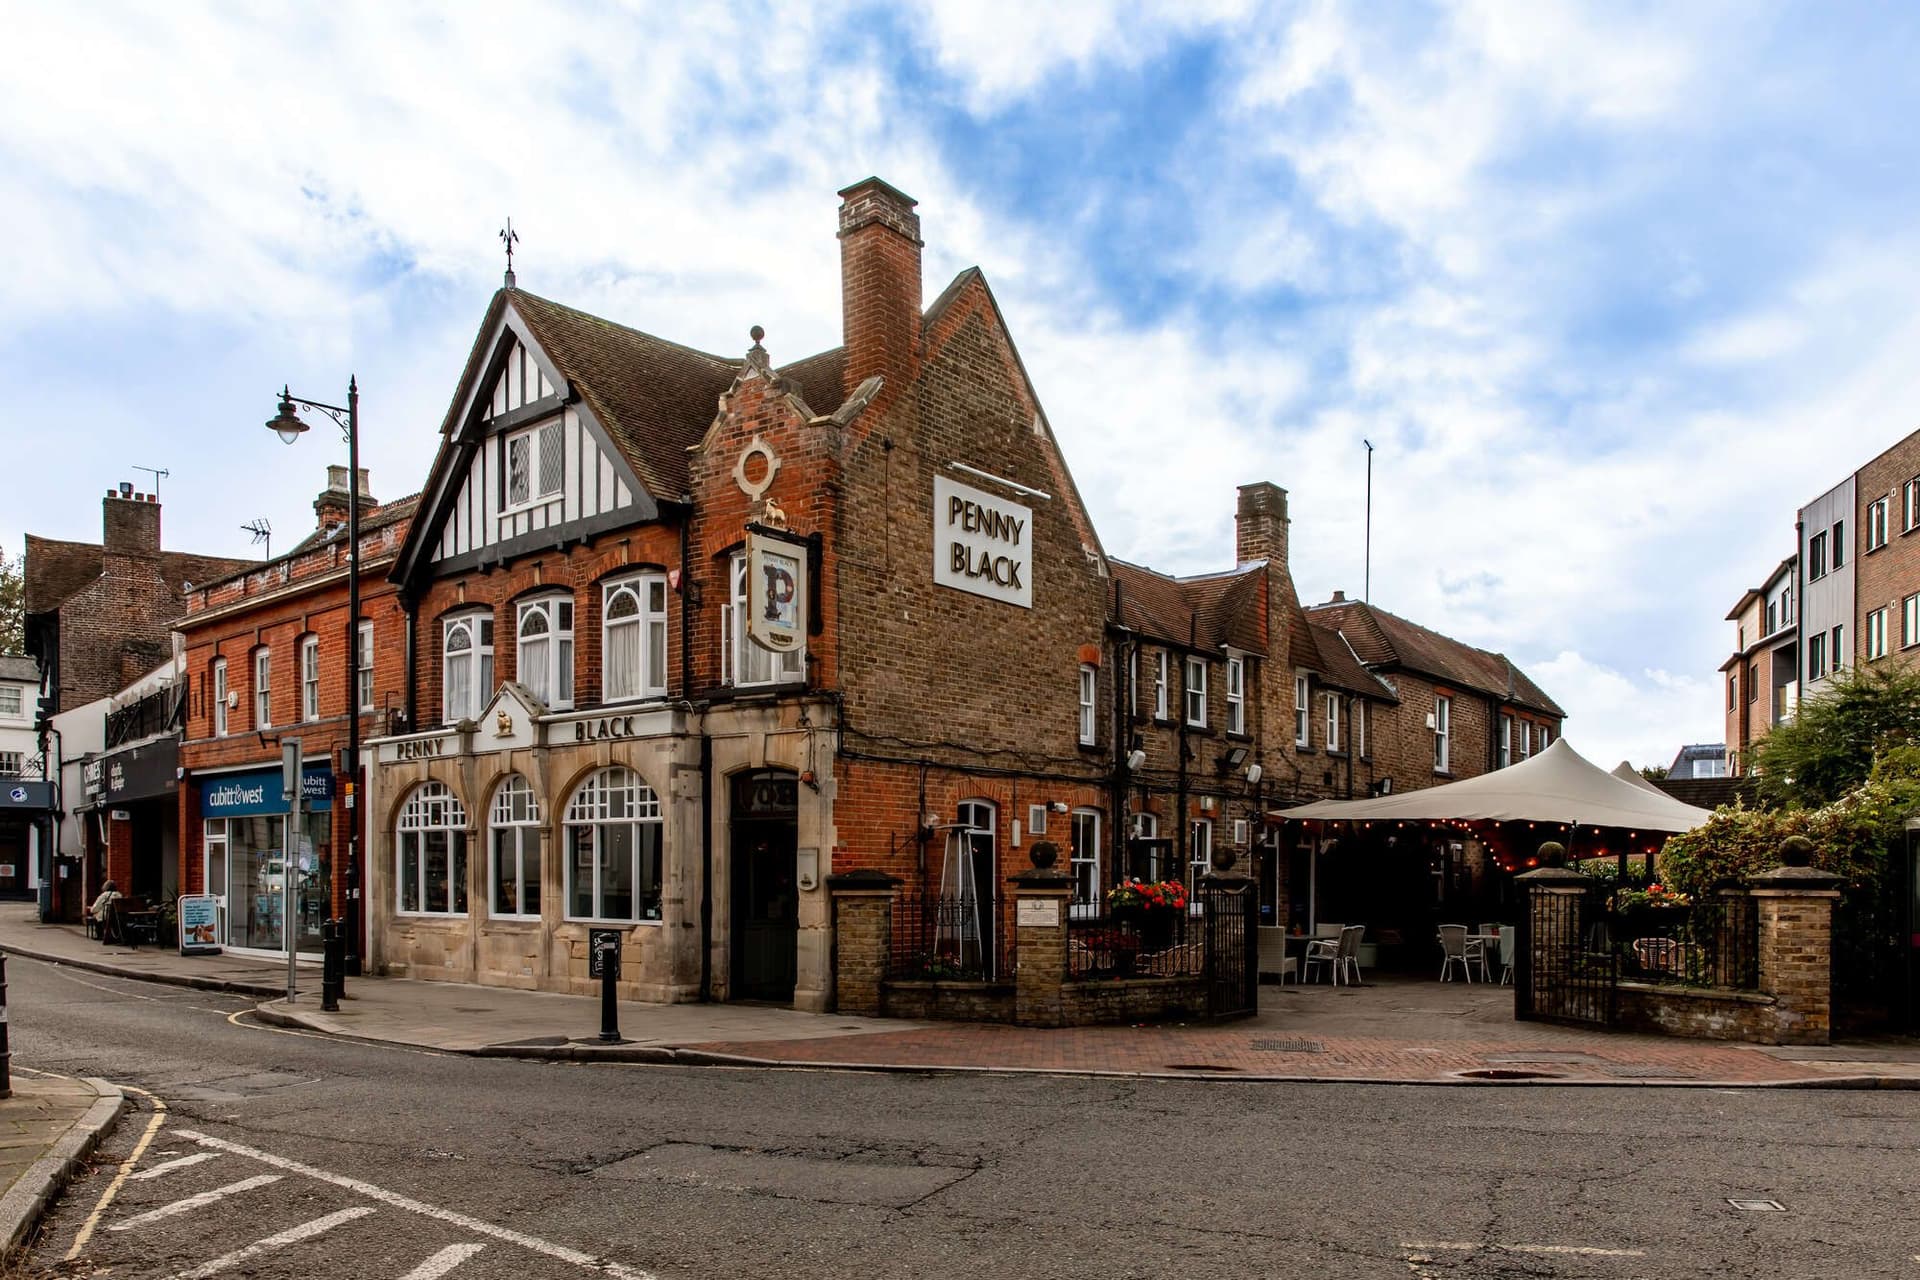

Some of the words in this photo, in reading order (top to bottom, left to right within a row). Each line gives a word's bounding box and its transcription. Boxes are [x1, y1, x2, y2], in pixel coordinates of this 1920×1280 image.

[948, 495, 1024, 546] PENNY
[951, 542, 1022, 589] BLACK
[396, 738, 444, 760] PENNY
[575, 716, 634, 741] BLACK
[303, 776, 326, 786] ubitt
